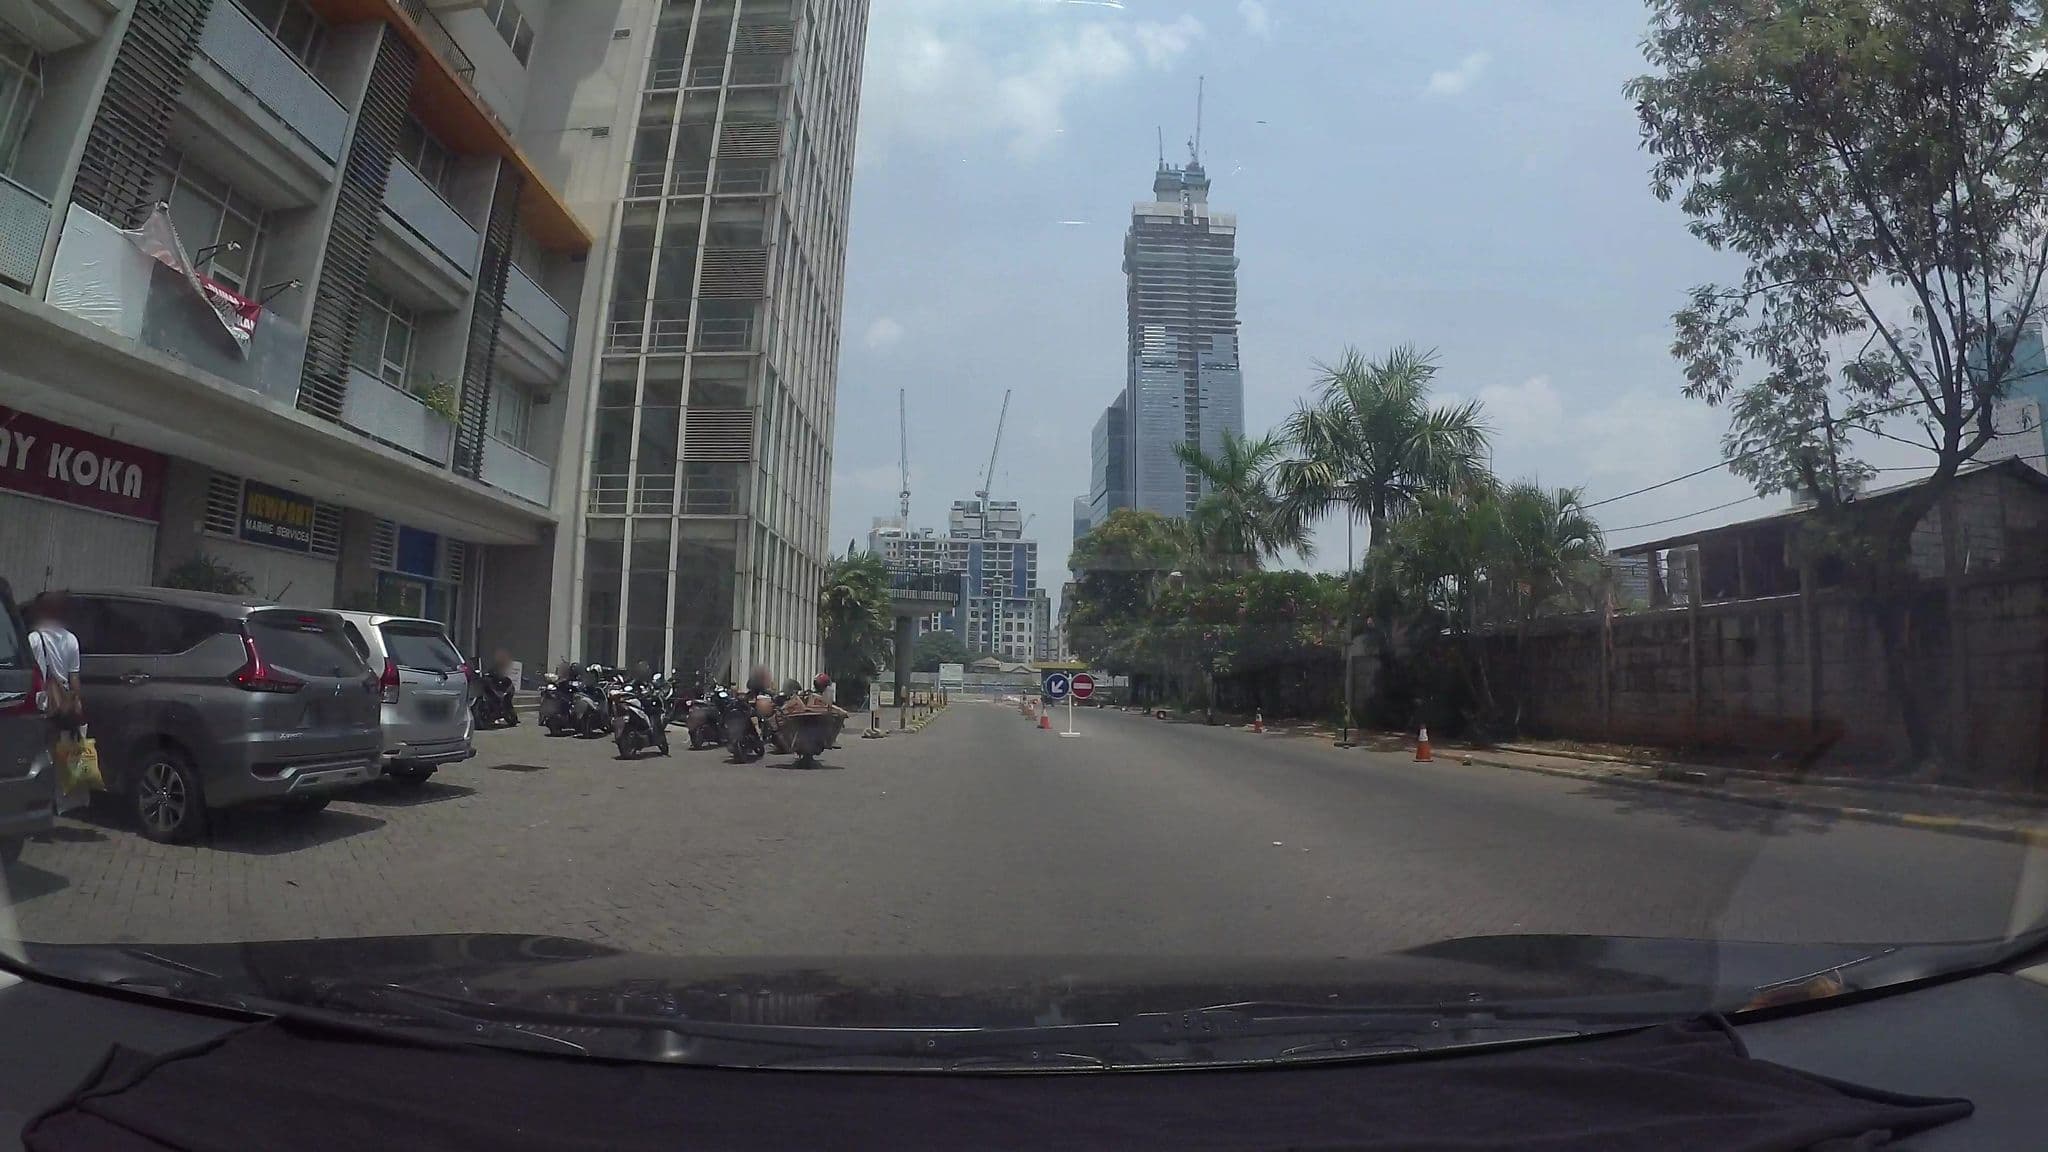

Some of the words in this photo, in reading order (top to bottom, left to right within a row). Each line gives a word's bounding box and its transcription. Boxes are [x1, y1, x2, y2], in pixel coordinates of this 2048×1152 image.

[48, 443, 142, 498] KOKA
[245, 520, 274, 534] MARINE
[276, 526, 310, 542] SERVICES
